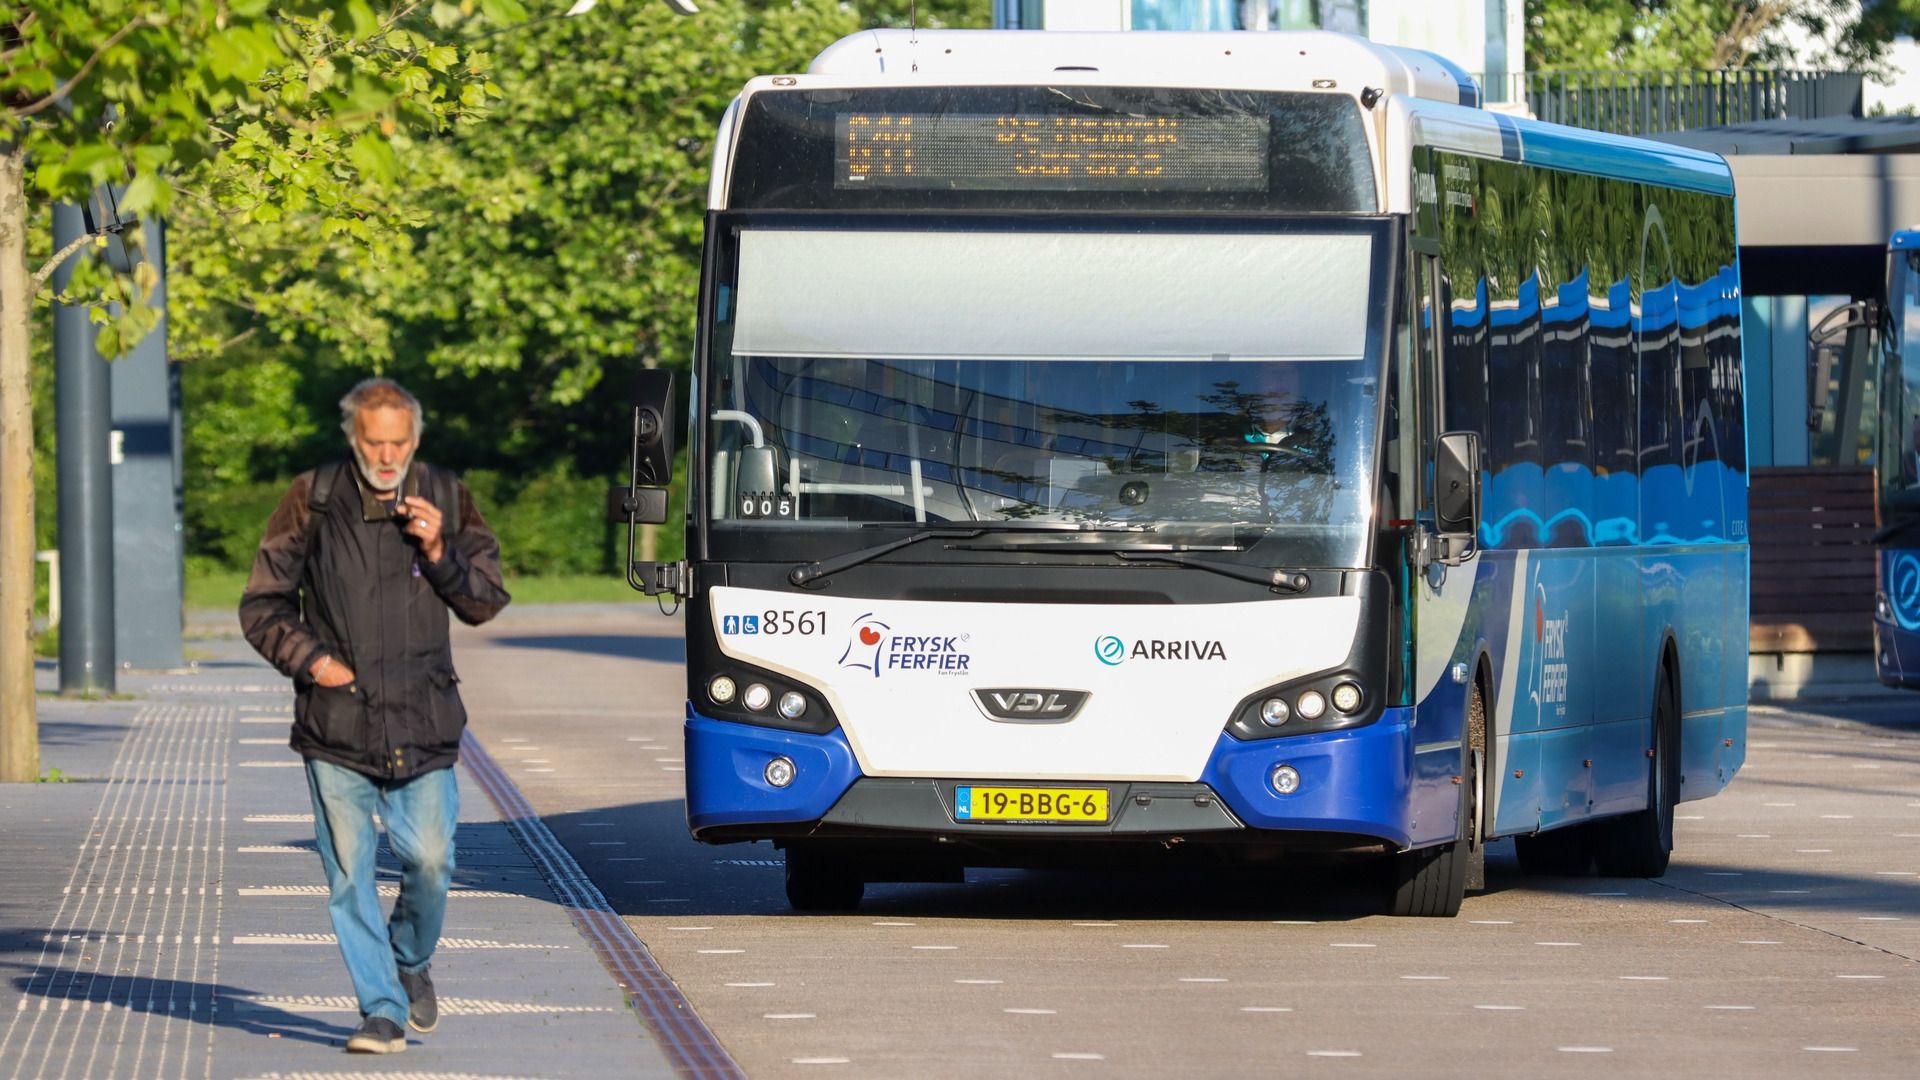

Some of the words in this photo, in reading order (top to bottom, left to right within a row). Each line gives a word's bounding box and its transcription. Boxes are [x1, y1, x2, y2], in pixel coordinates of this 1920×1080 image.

[763, 610, 826, 635] 8561
[891, 636, 958, 652] FRYSK
[1544, 619, 1565, 659] FRYSK
[1131, 640, 1227, 660] ARRIVA
[888, 654, 970, 670] FERFIER
[990, 693, 1067, 712] VDL
[958, 806, 969, 814] NL
[983, 793, 1097, 816] 19-BBG-6
